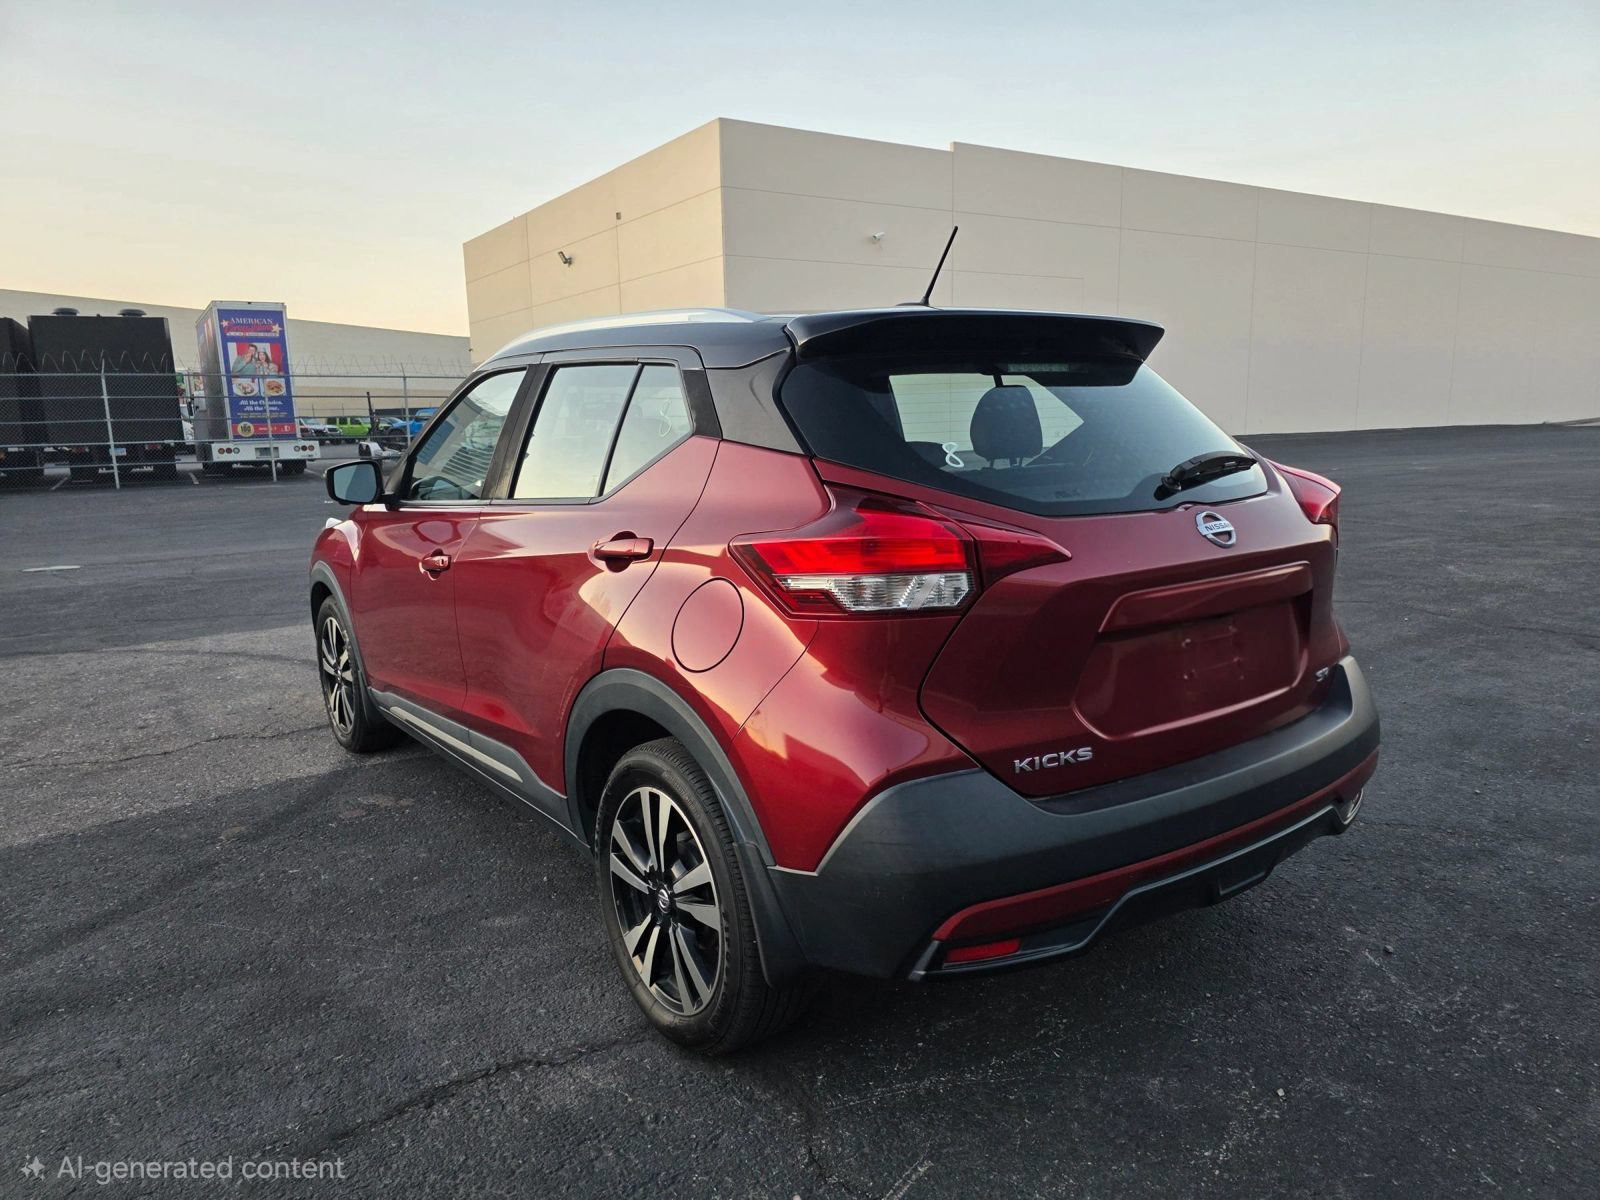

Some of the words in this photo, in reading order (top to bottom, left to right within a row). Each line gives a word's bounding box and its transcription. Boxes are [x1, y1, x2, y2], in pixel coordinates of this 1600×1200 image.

[231, 317, 273, 325] AMERICAN
[942, 442, 964, 467] 8
[1013, 746, 1093, 774] KICKS
